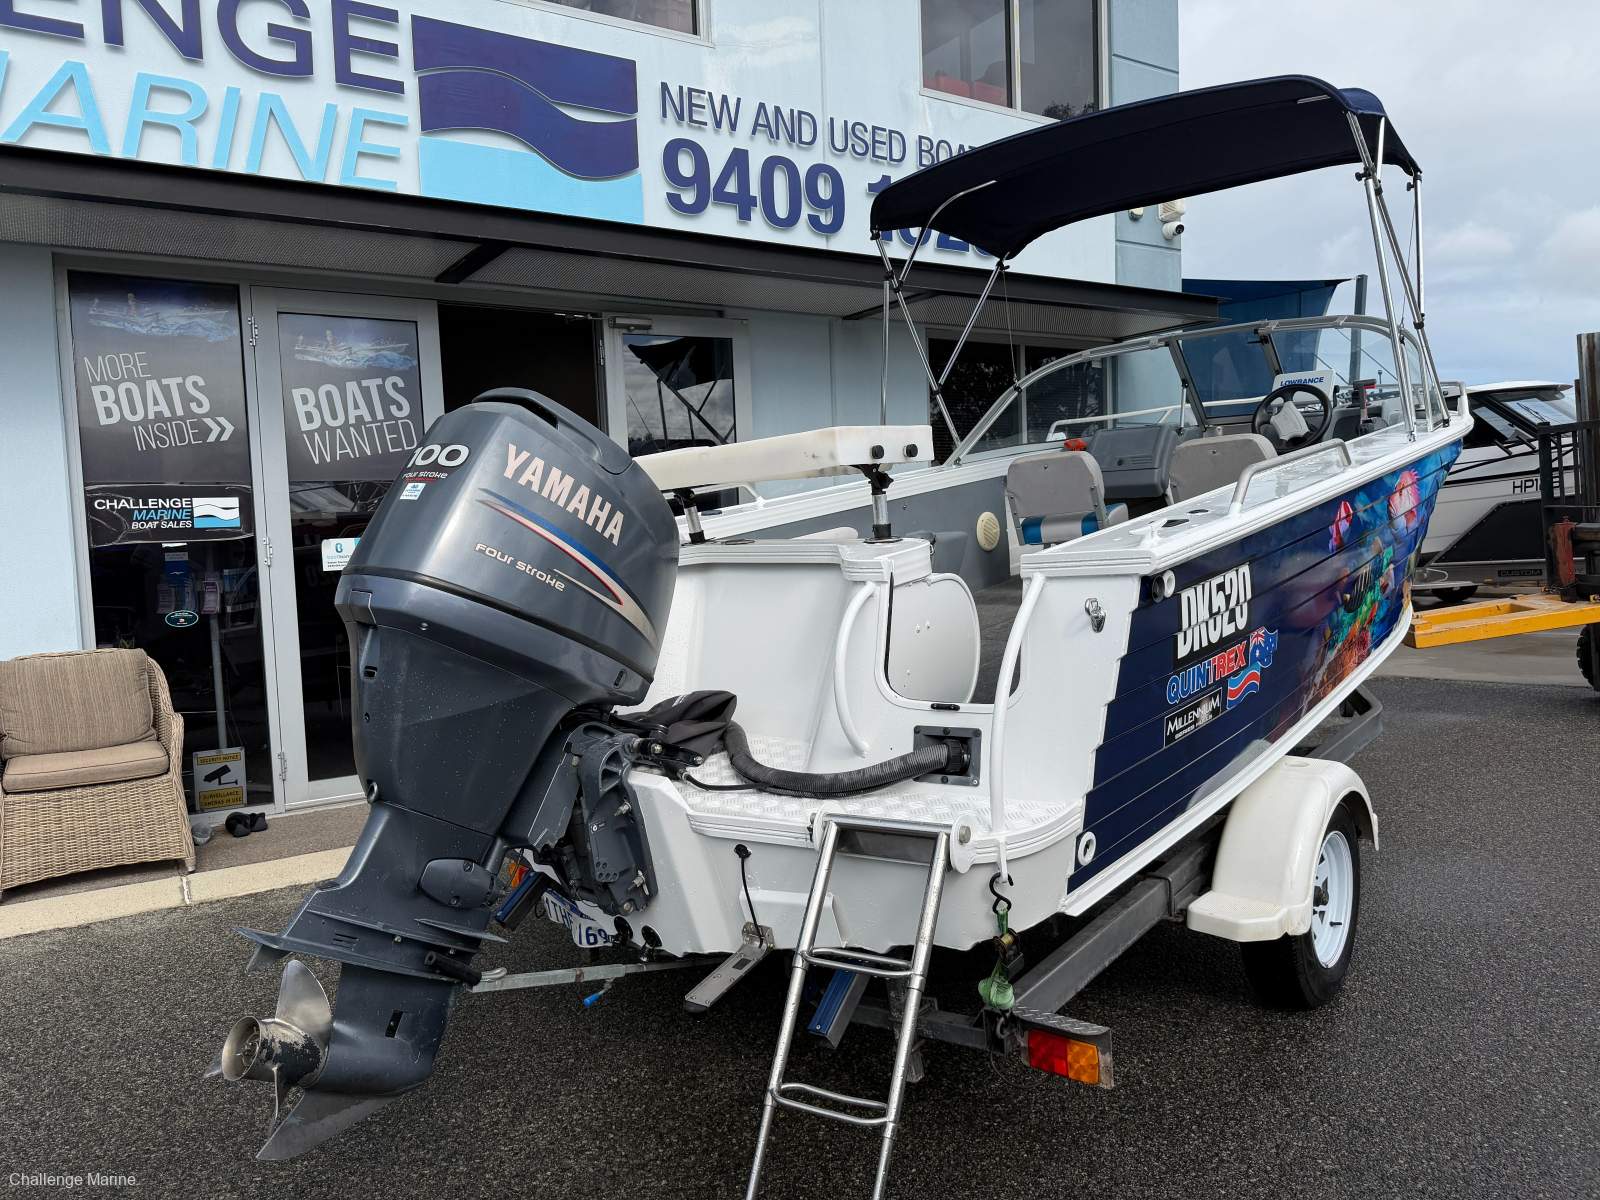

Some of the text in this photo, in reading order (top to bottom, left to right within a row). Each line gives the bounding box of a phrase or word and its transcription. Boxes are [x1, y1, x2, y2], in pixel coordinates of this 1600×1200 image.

[0, 50, 408, 191] ARINE
[660, 82, 978, 168] NEW AND USED BO
[662, 137, 846, 235] 9409
[84, 352, 151, 383] MORE
[1280, 376, 1325, 387] LOWRANCE
[91, 375, 211, 427] BOATS
[292, 375, 411, 432] BOATS
[132, 417, 203, 451] INSIDE
[303, 419, 418, 465] WANTED
[407, 444, 470, 468] 100
[94, 497, 192, 510] CHALLENGE
[133, 509, 192, 521] MARINE
[503, 443, 625, 547] YAMAHA
[131, 520, 192, 530] BOAT SALES
[1178, 564, 1252, 660] DK520
[1167, 640, 1248, 704] QUINTREX
[578, 922, 609, 946] 169
